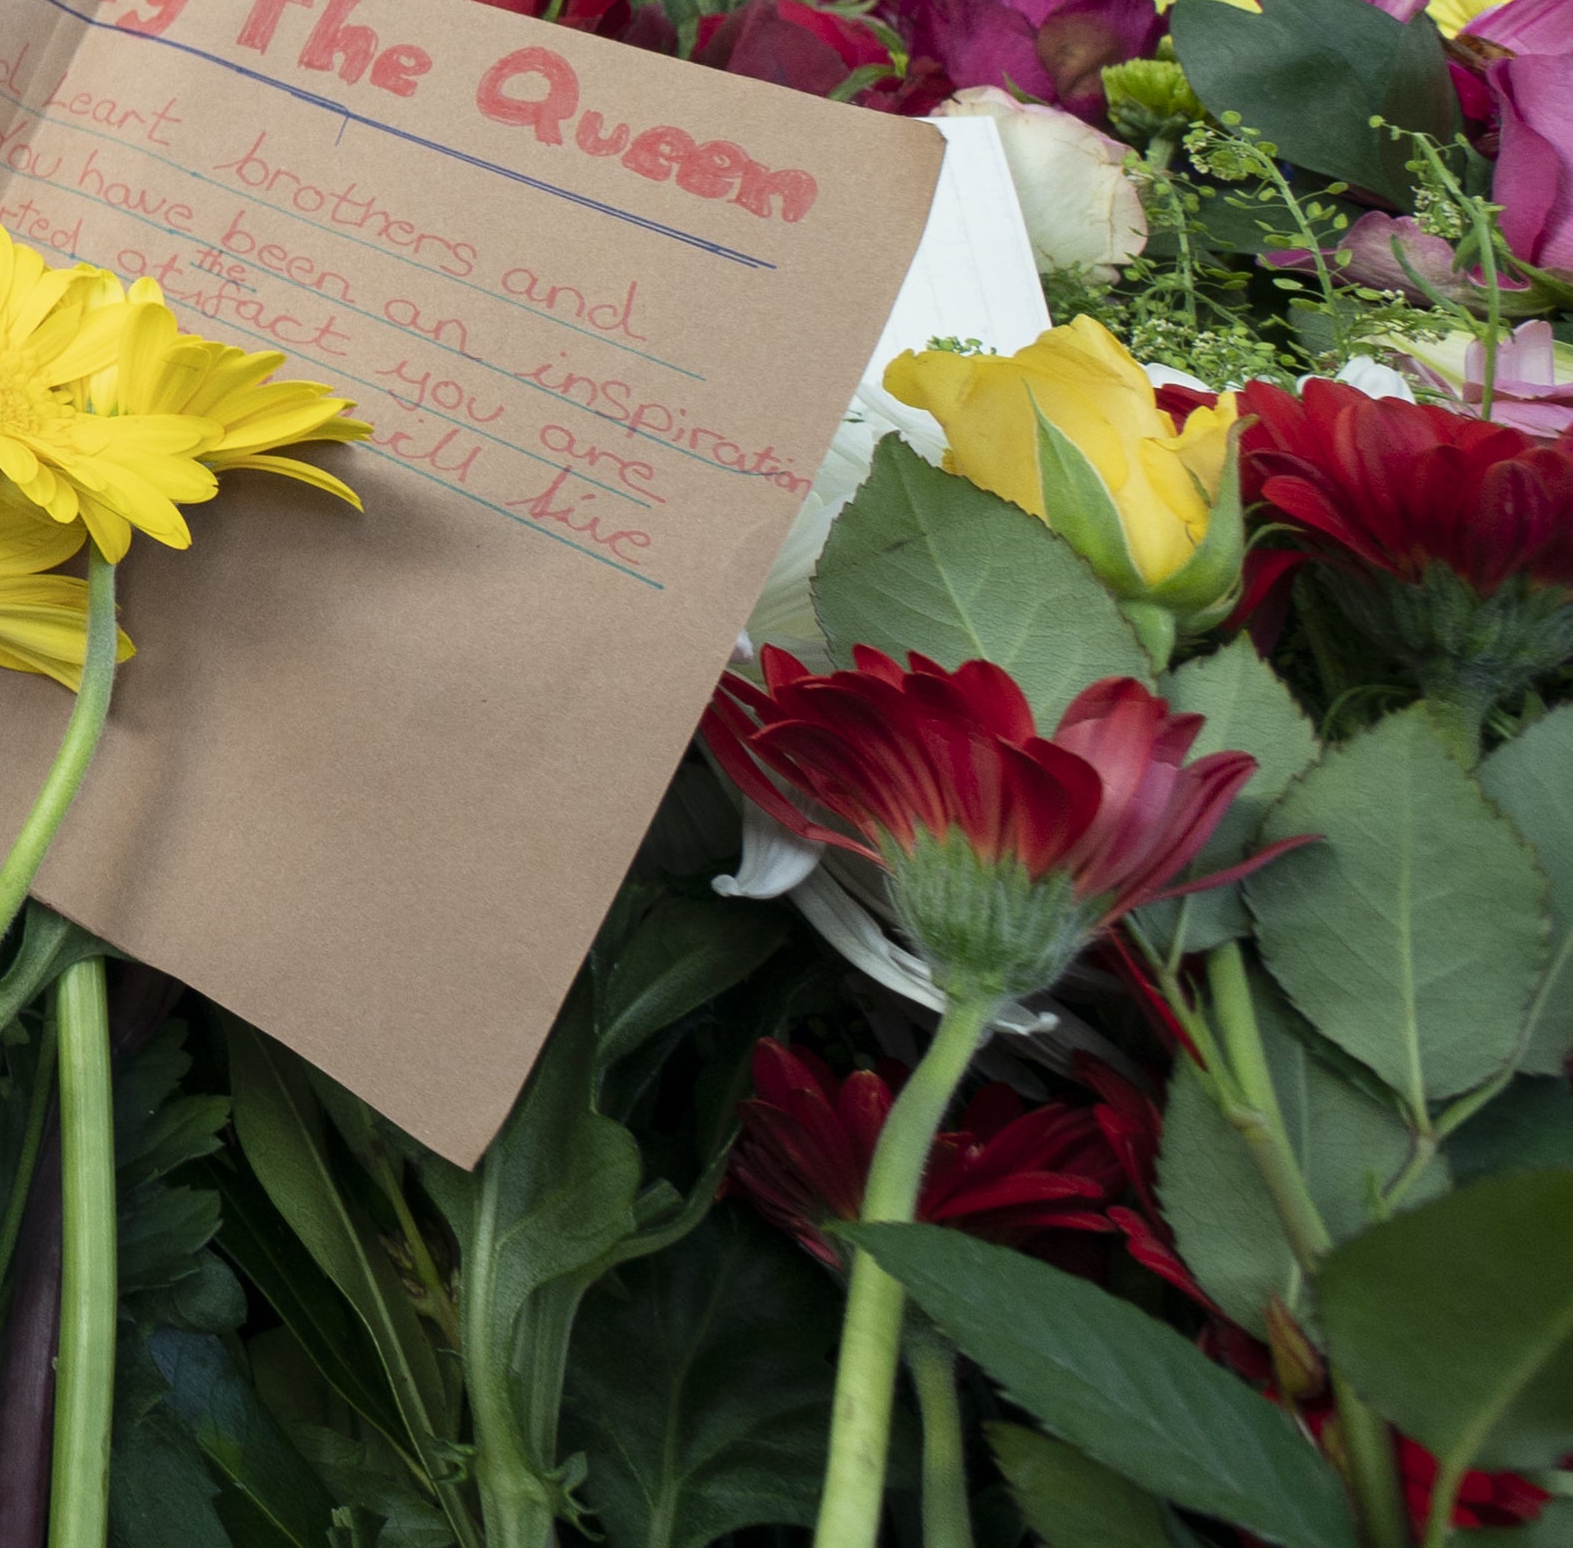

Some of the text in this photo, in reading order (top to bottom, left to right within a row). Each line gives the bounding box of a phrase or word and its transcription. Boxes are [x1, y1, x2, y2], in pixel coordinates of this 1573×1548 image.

[475, 45, 819, 223] Queen
[77, 148, 194, 233] have
[219, 209, 356, 304] been
[383, 298, 484, 363] an
[116, 248, 189, 299] at
[195, 247, 247, 283] the
[212, 131, 477, 278] brothers
[500, 267, 647, 343] and
[201, 280, 351, 356] fact
[374, 359, 505, 424] you
[539, 423, 667, 504] are
